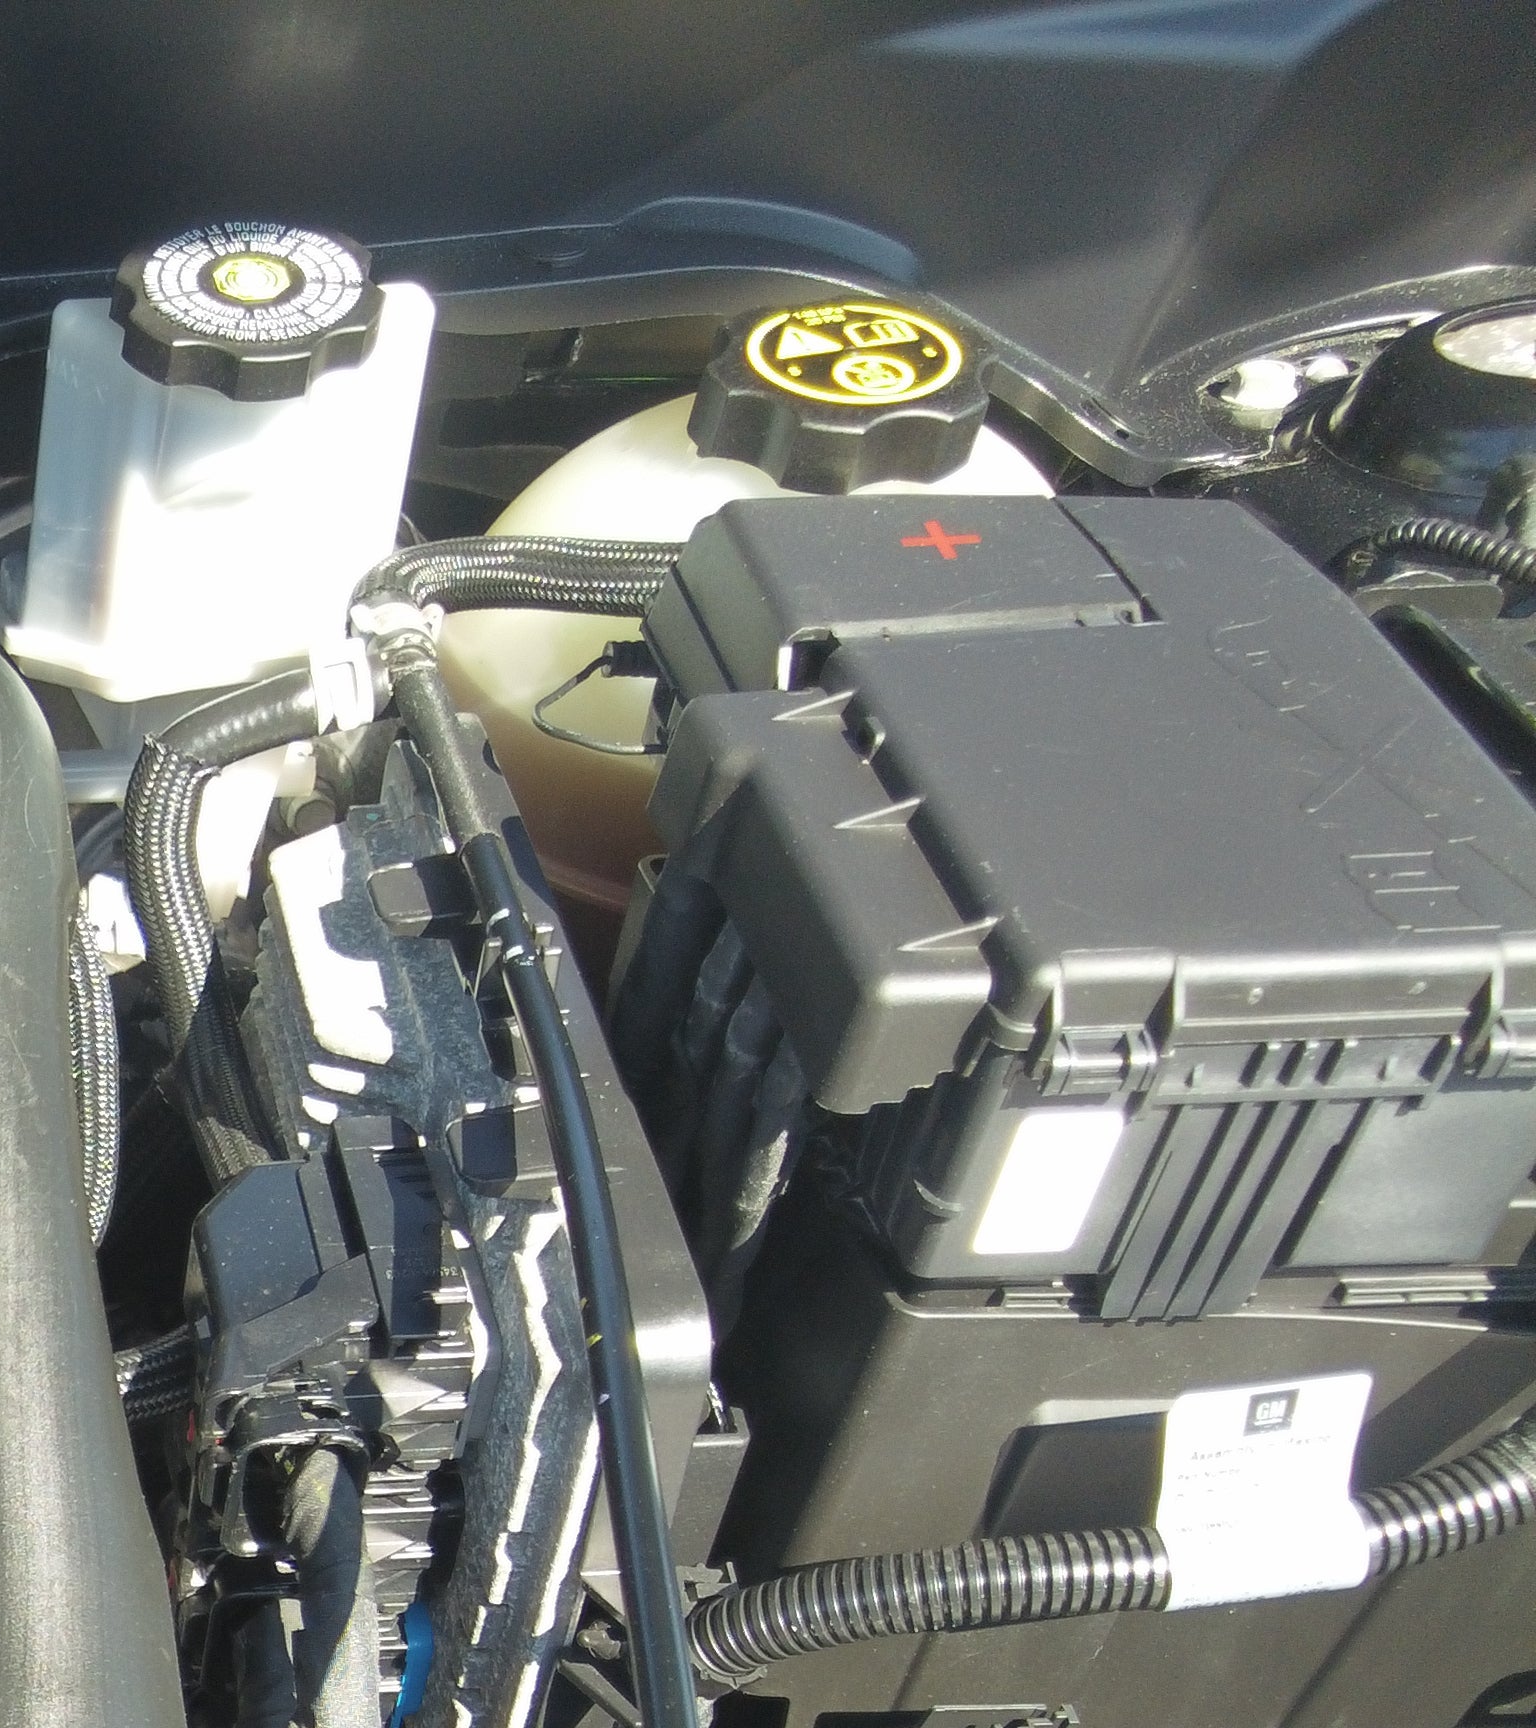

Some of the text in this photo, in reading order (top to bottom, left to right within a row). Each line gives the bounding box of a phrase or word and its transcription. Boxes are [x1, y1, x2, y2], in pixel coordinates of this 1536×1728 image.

[205, 223, 222, 236] LE
[224, 221, 286, 235] BOUCHON
[229, 231, 279, 244] LIQUIDE
[1256, 1399, 1288, 1421] GM
